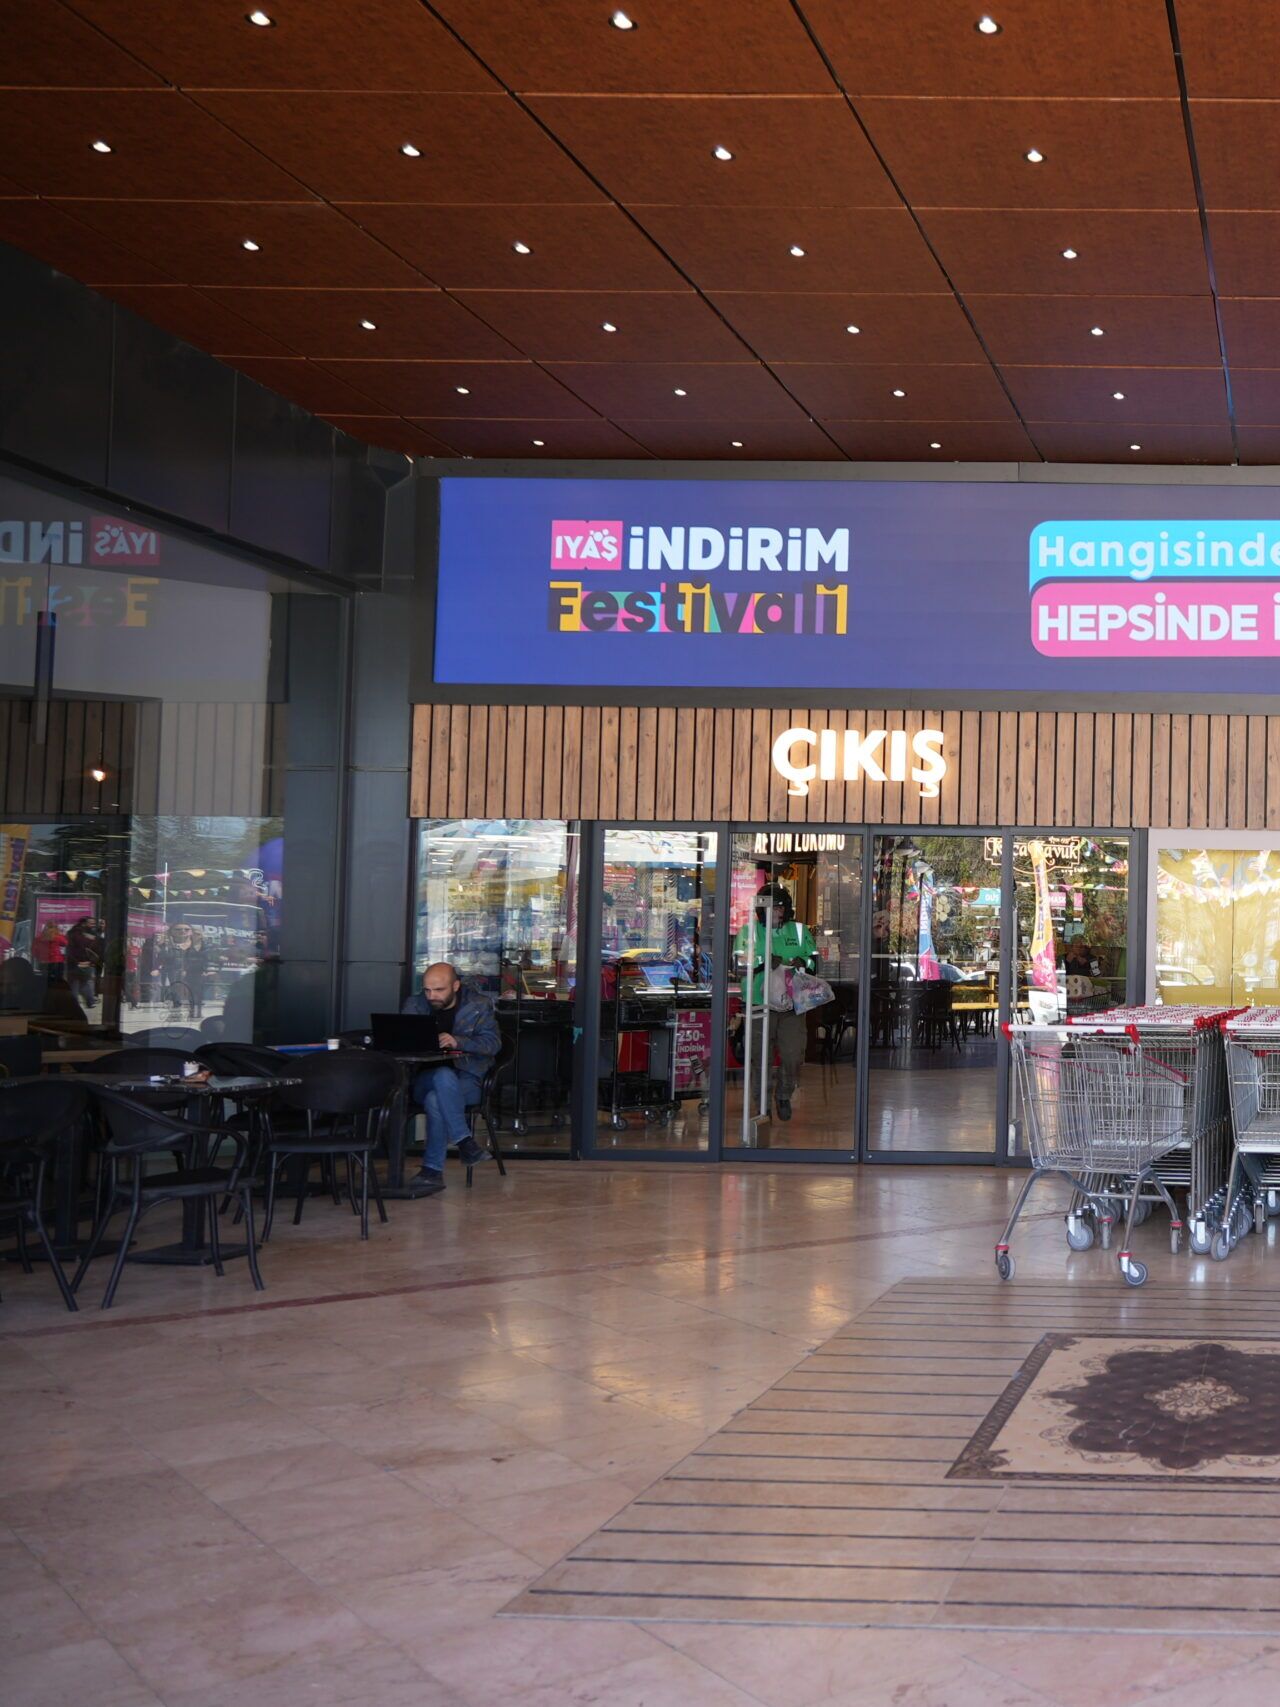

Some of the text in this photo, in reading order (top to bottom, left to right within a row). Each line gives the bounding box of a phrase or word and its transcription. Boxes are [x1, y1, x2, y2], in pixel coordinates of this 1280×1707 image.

[548, 577, 849, 635] Festivali
[1038, 592, 1258, 641] HEPSİNDE
[772, 727, 947, 798] ÇIKIŞ
